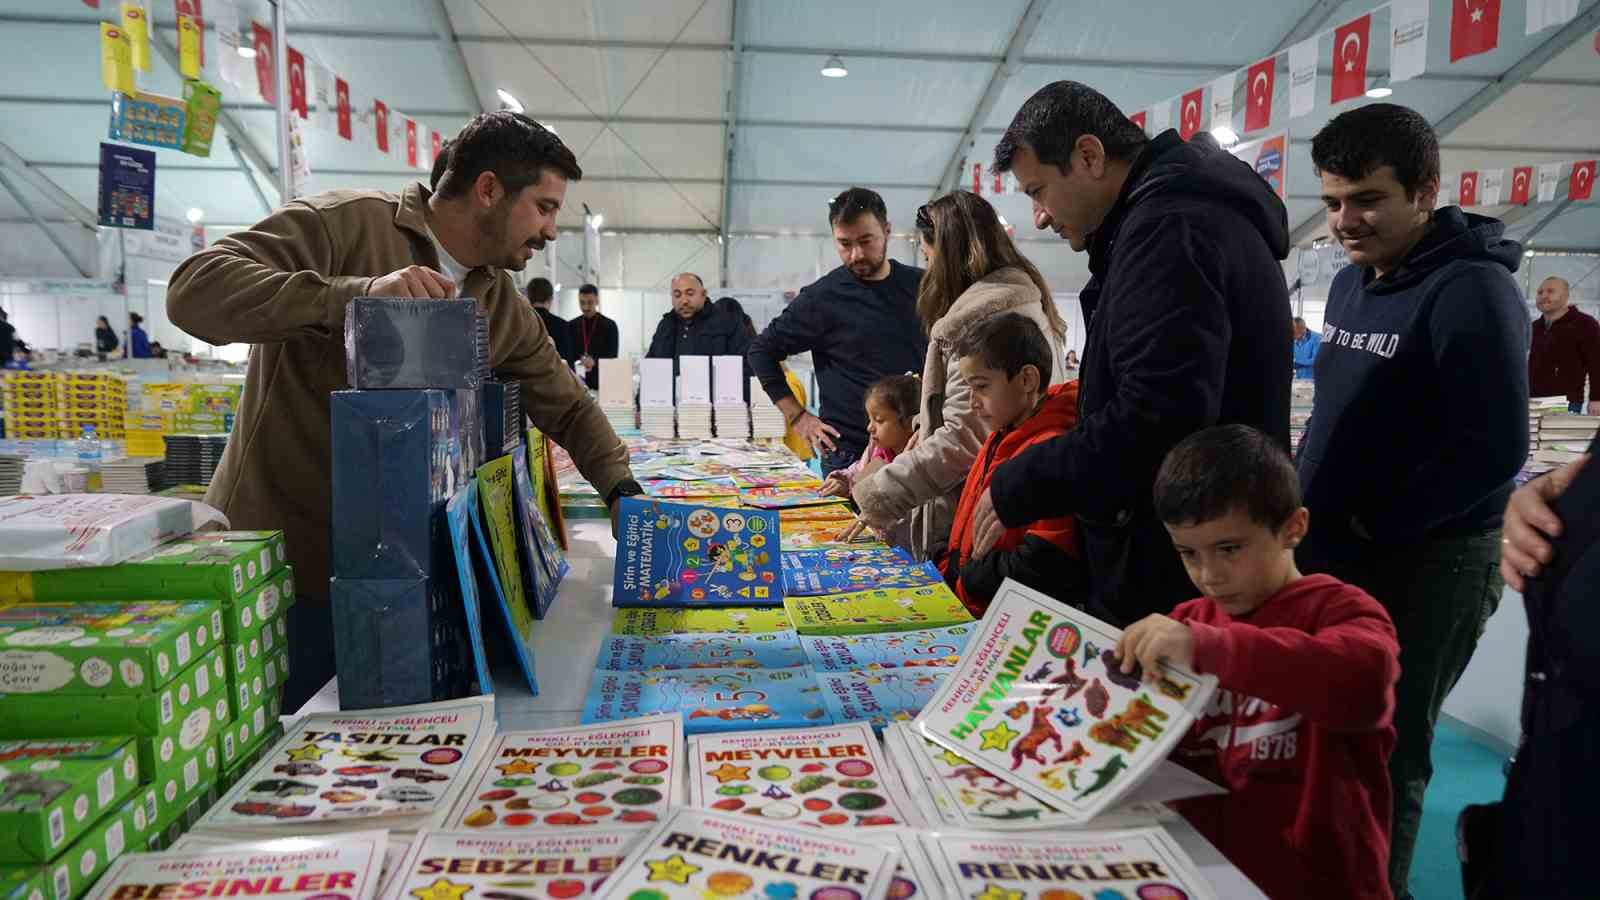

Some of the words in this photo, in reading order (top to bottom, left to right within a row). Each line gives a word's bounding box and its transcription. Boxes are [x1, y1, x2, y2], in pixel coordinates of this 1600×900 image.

[1336, 329, 1350, 346] TO
[1350, 334, 1367, 350] BE
[1366, 333, 1400, 358] WILD
[626, 514, 640, 547] Eğitici
[726, 518, 742, 530] 3
[627, 549, 637, 563] ve
[639, 519, 654, 588] MATEMATİK
[686, 558, 699, 566] 2
[623, 566, 637, 591] Şirin
[949, 610, 1052, 740] HAYVANLAR
[970, 669, 978, 678] ve
[502, 744, 669, 758] MEYVELER
[704, 744, 867, 762] MEYVELER
[1250, 734, 1297, 760] 1978
[662, 832, 869, 885] RENKLER
[958, 861, 1168, 880] RENKLER
